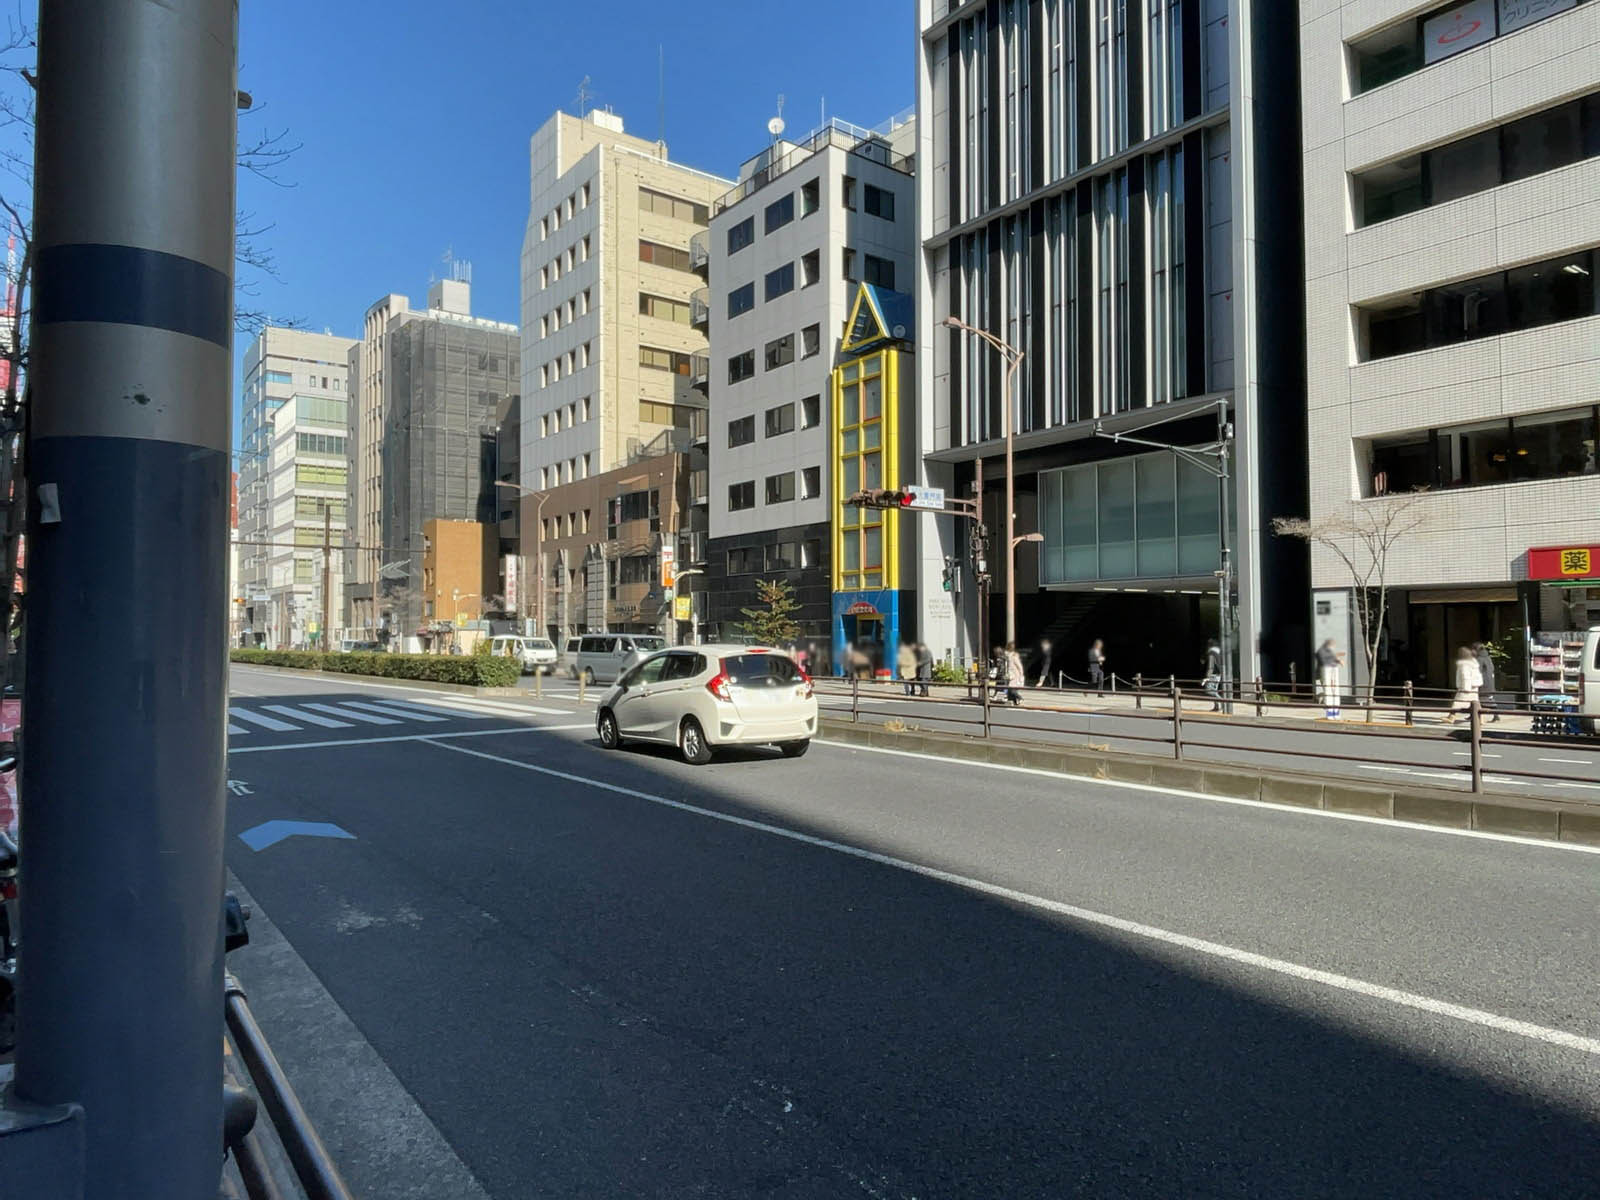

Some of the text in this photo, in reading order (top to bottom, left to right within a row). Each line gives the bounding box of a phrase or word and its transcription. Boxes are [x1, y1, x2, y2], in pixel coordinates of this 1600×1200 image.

[1503, 0, 1567, 25] クリニッ
[1563, 551, 1588, 571] 薬
